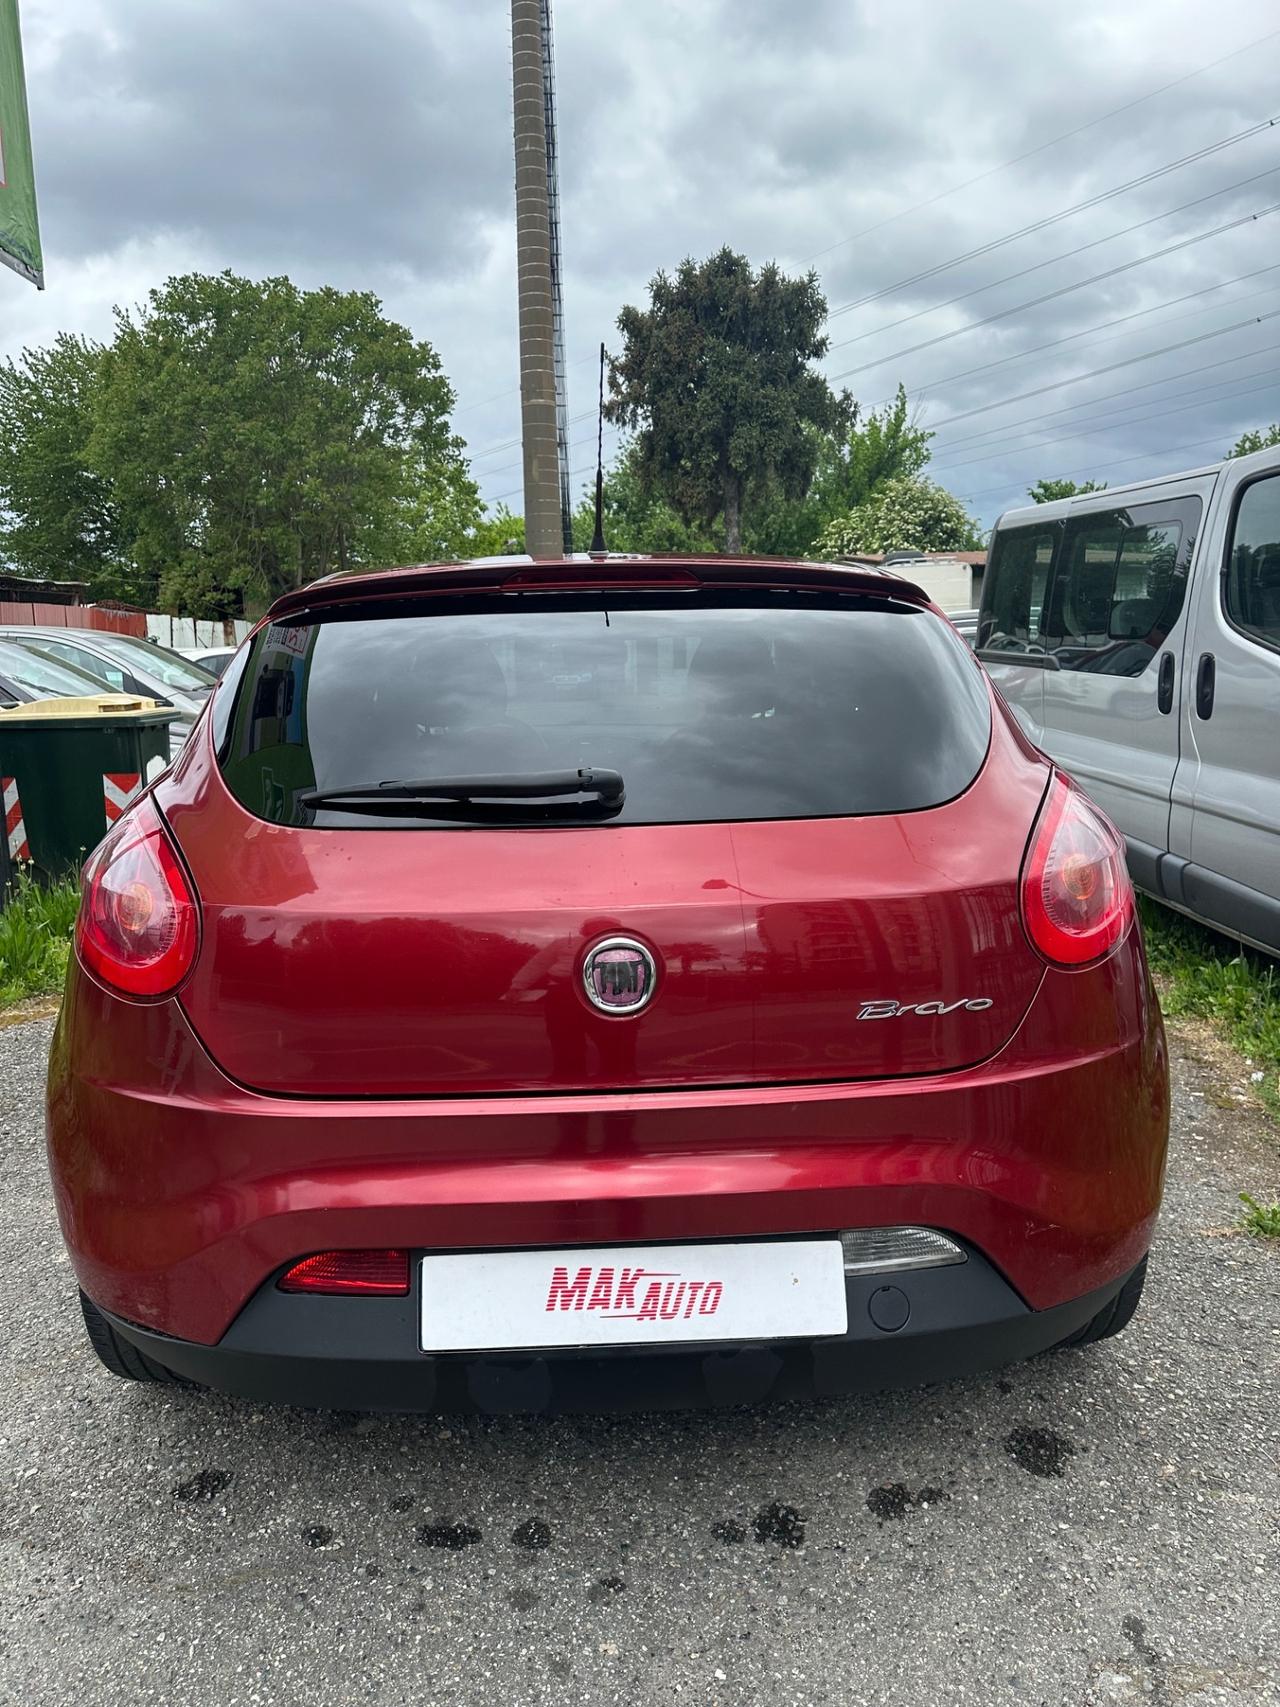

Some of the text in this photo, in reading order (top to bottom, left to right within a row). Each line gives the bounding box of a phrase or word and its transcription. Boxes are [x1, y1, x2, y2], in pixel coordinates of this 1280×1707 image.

[856, 998, 993, 1020] Bravo
[545, 1266, 724, 1321] MAK AUTO
